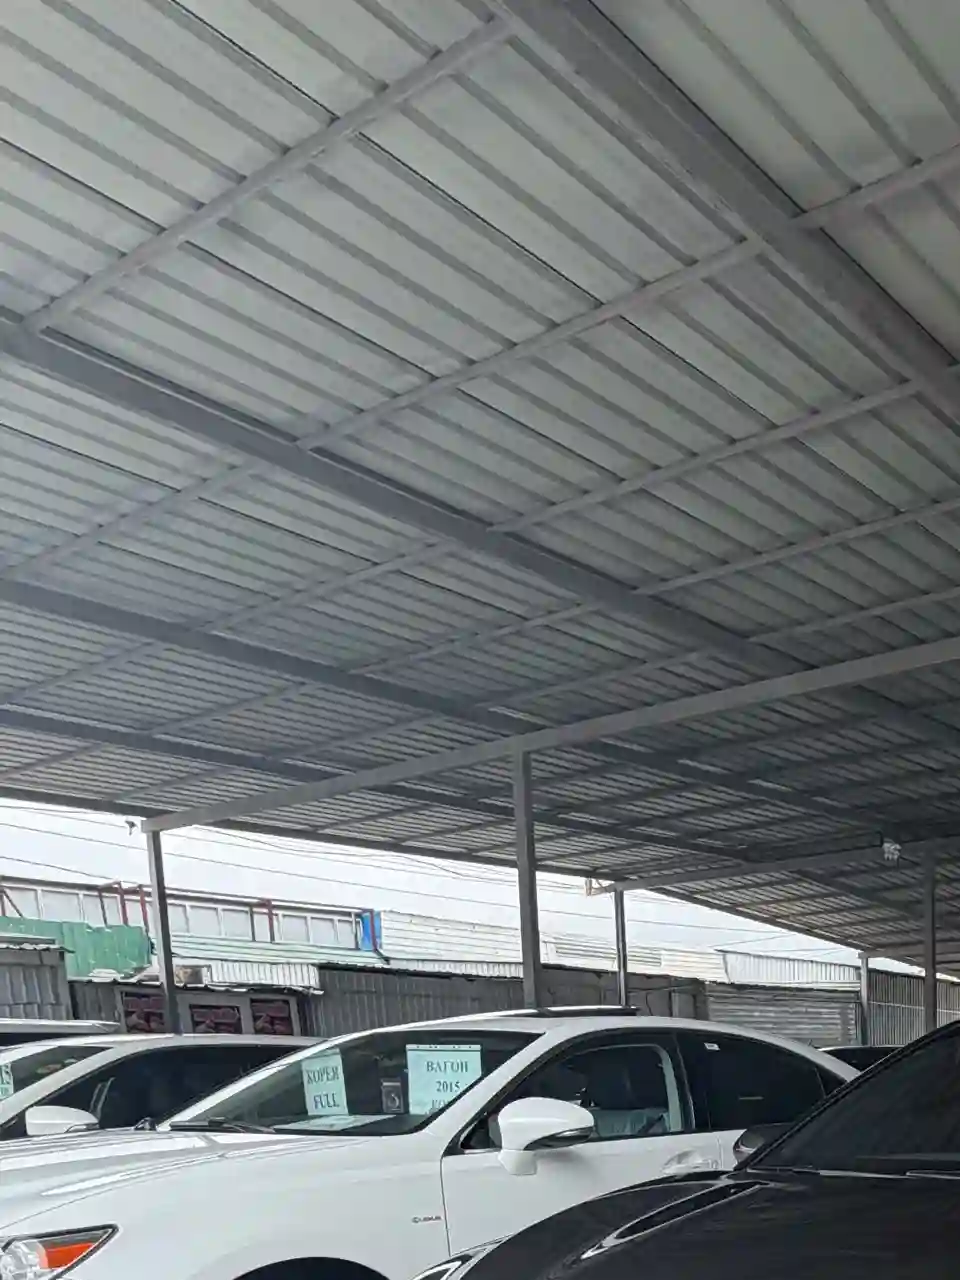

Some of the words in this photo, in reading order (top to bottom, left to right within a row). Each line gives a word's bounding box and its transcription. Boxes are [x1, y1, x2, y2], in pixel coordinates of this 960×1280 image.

[426, 1060, 468, 1073] ВАГОН
[436, 1080, 460, 1093] 2015
[313, 1092, 340, 1110] FULL
